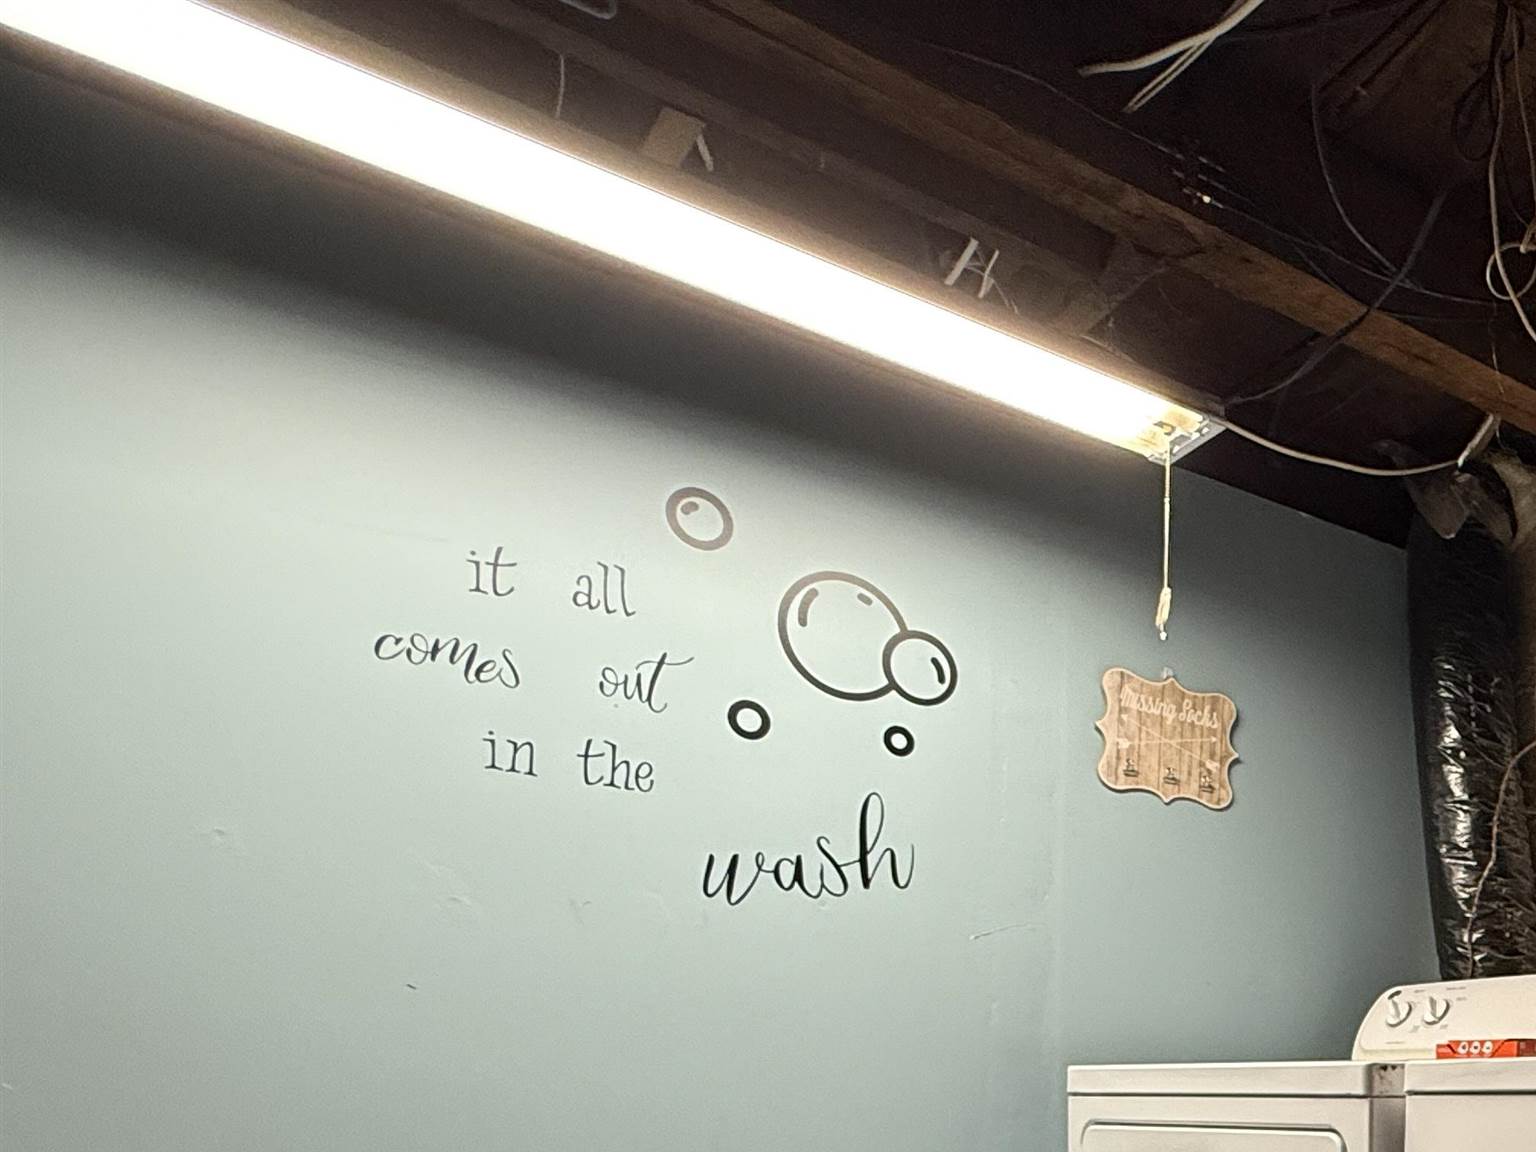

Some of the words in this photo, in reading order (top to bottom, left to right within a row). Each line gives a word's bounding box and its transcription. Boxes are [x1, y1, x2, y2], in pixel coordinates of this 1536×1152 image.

[467, 546, 517, 597] it
[572, 562, 636, 617] all
[374, 632, 520, 688] comes
[599, 652, 694, 713] out
[483, 731, 538, 776] in
[577, 738, 655, 792] the
[702, 792, 915, 906] wash
